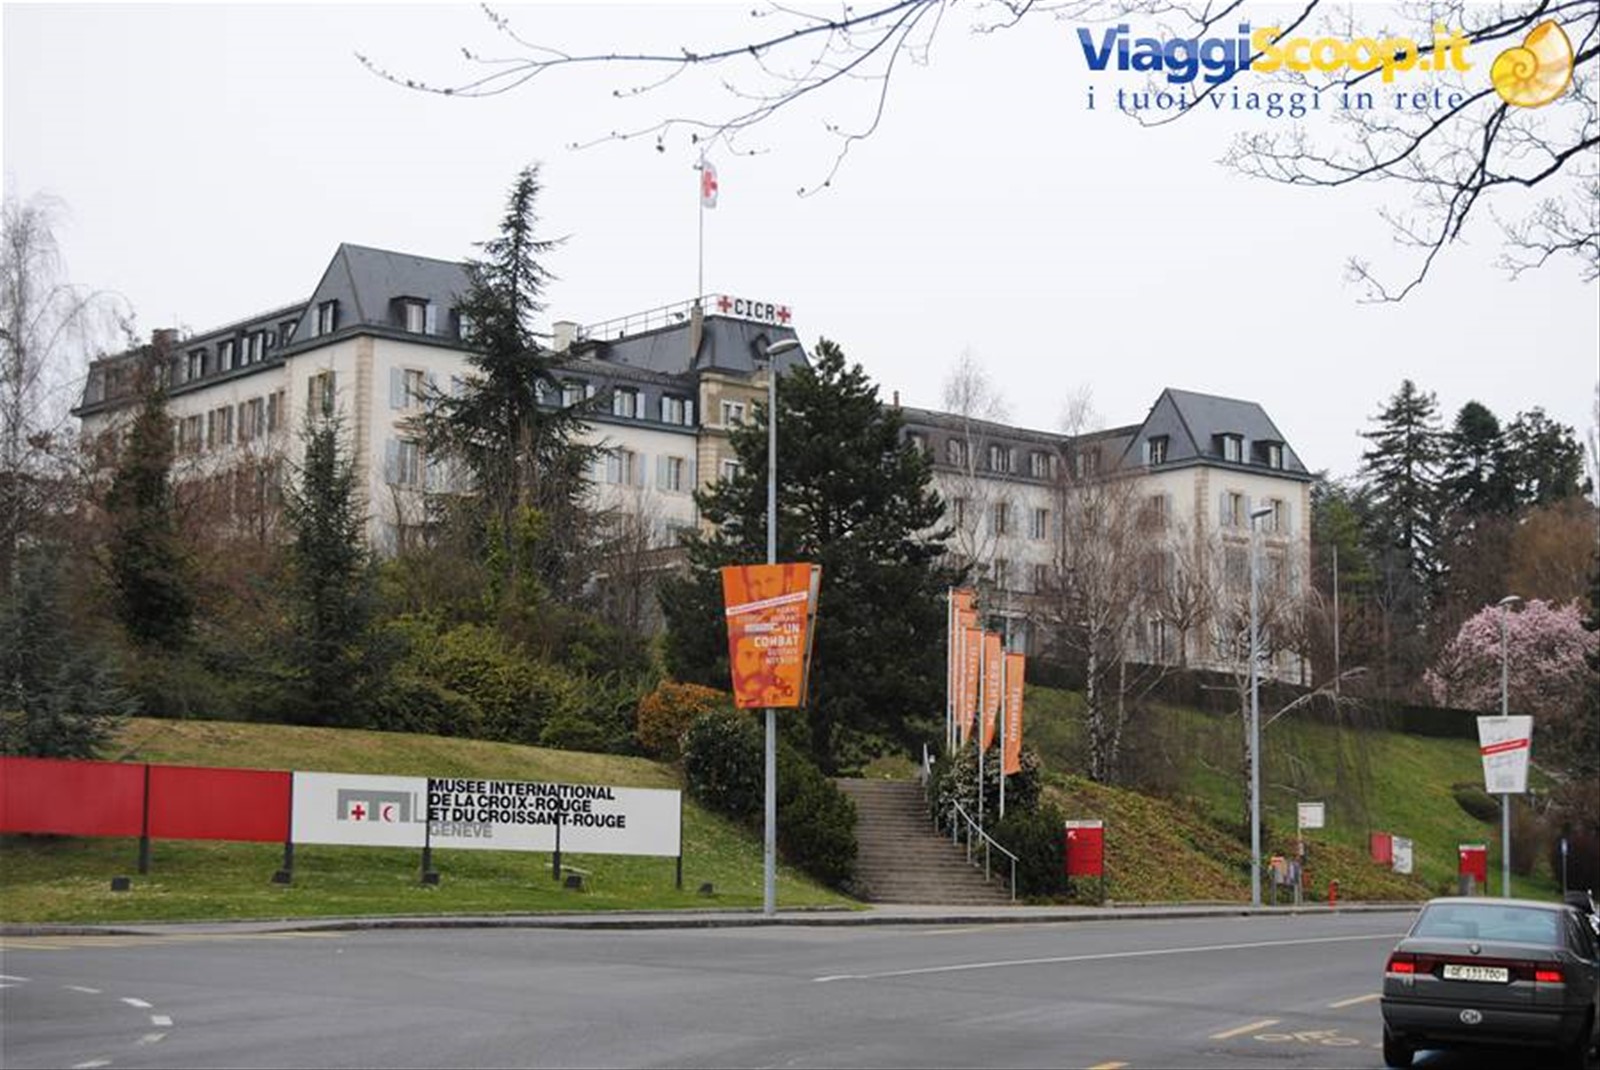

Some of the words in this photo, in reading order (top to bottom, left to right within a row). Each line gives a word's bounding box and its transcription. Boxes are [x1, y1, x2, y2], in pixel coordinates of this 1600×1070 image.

[734, 298, 775, 320] CICR
[754, 635, 799, 648] COMBAT
[429, 779, 486, 794] MUSEE
[490, 781, 615, 800] INTERNATIONAL
[429, 793, 453, 807] DE
[455, 794, 476, 808] LA
[477, 795, 592, 813] CROIX-ROUGE
[429, 807, 450, 821] ET
[452, 808, 475, 822] DU
[477, 809, 626, 829] CROISSANT-ROUGE
